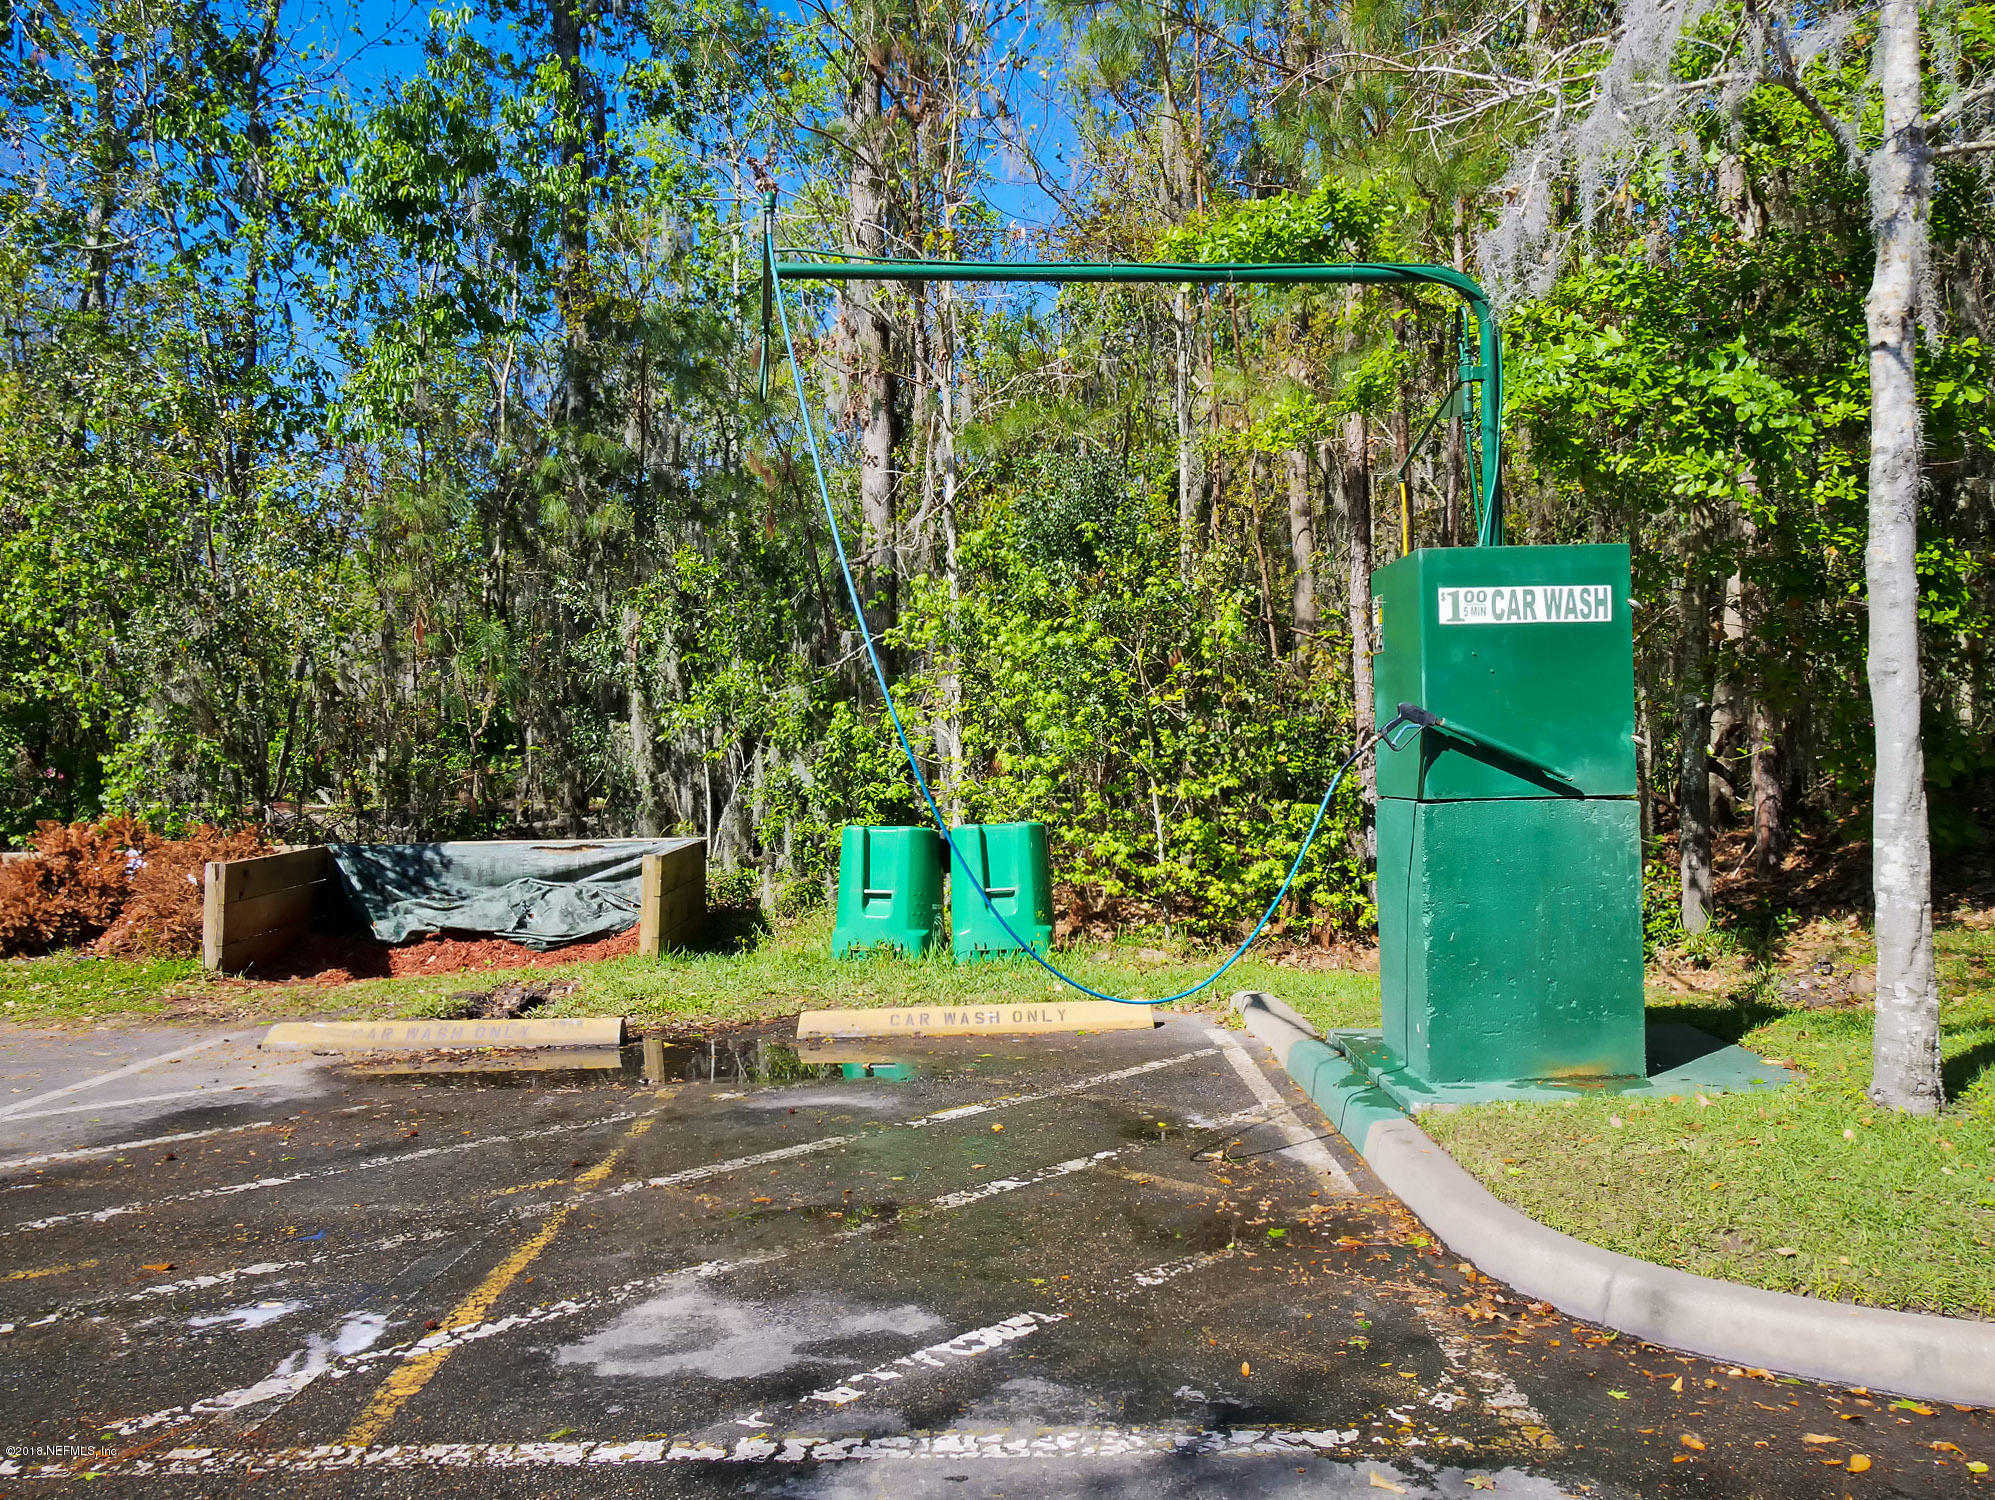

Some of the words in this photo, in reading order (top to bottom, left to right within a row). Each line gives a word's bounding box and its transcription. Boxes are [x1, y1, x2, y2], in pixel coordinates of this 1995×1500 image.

[1471, 606, 1486, 617] MIN
[1491, 589, 1537, 621] CAR
[1543, 587, 1609, 620] WASH
[890, 1013, 930, 1026] CAR
[944, 1010, 1000, 1025] WASH
[1012, 1008, 1067, 1023] ONLY
[406, 1026, 464, 1041] WASH
[474, 1024, 530, 1040] ONLY
